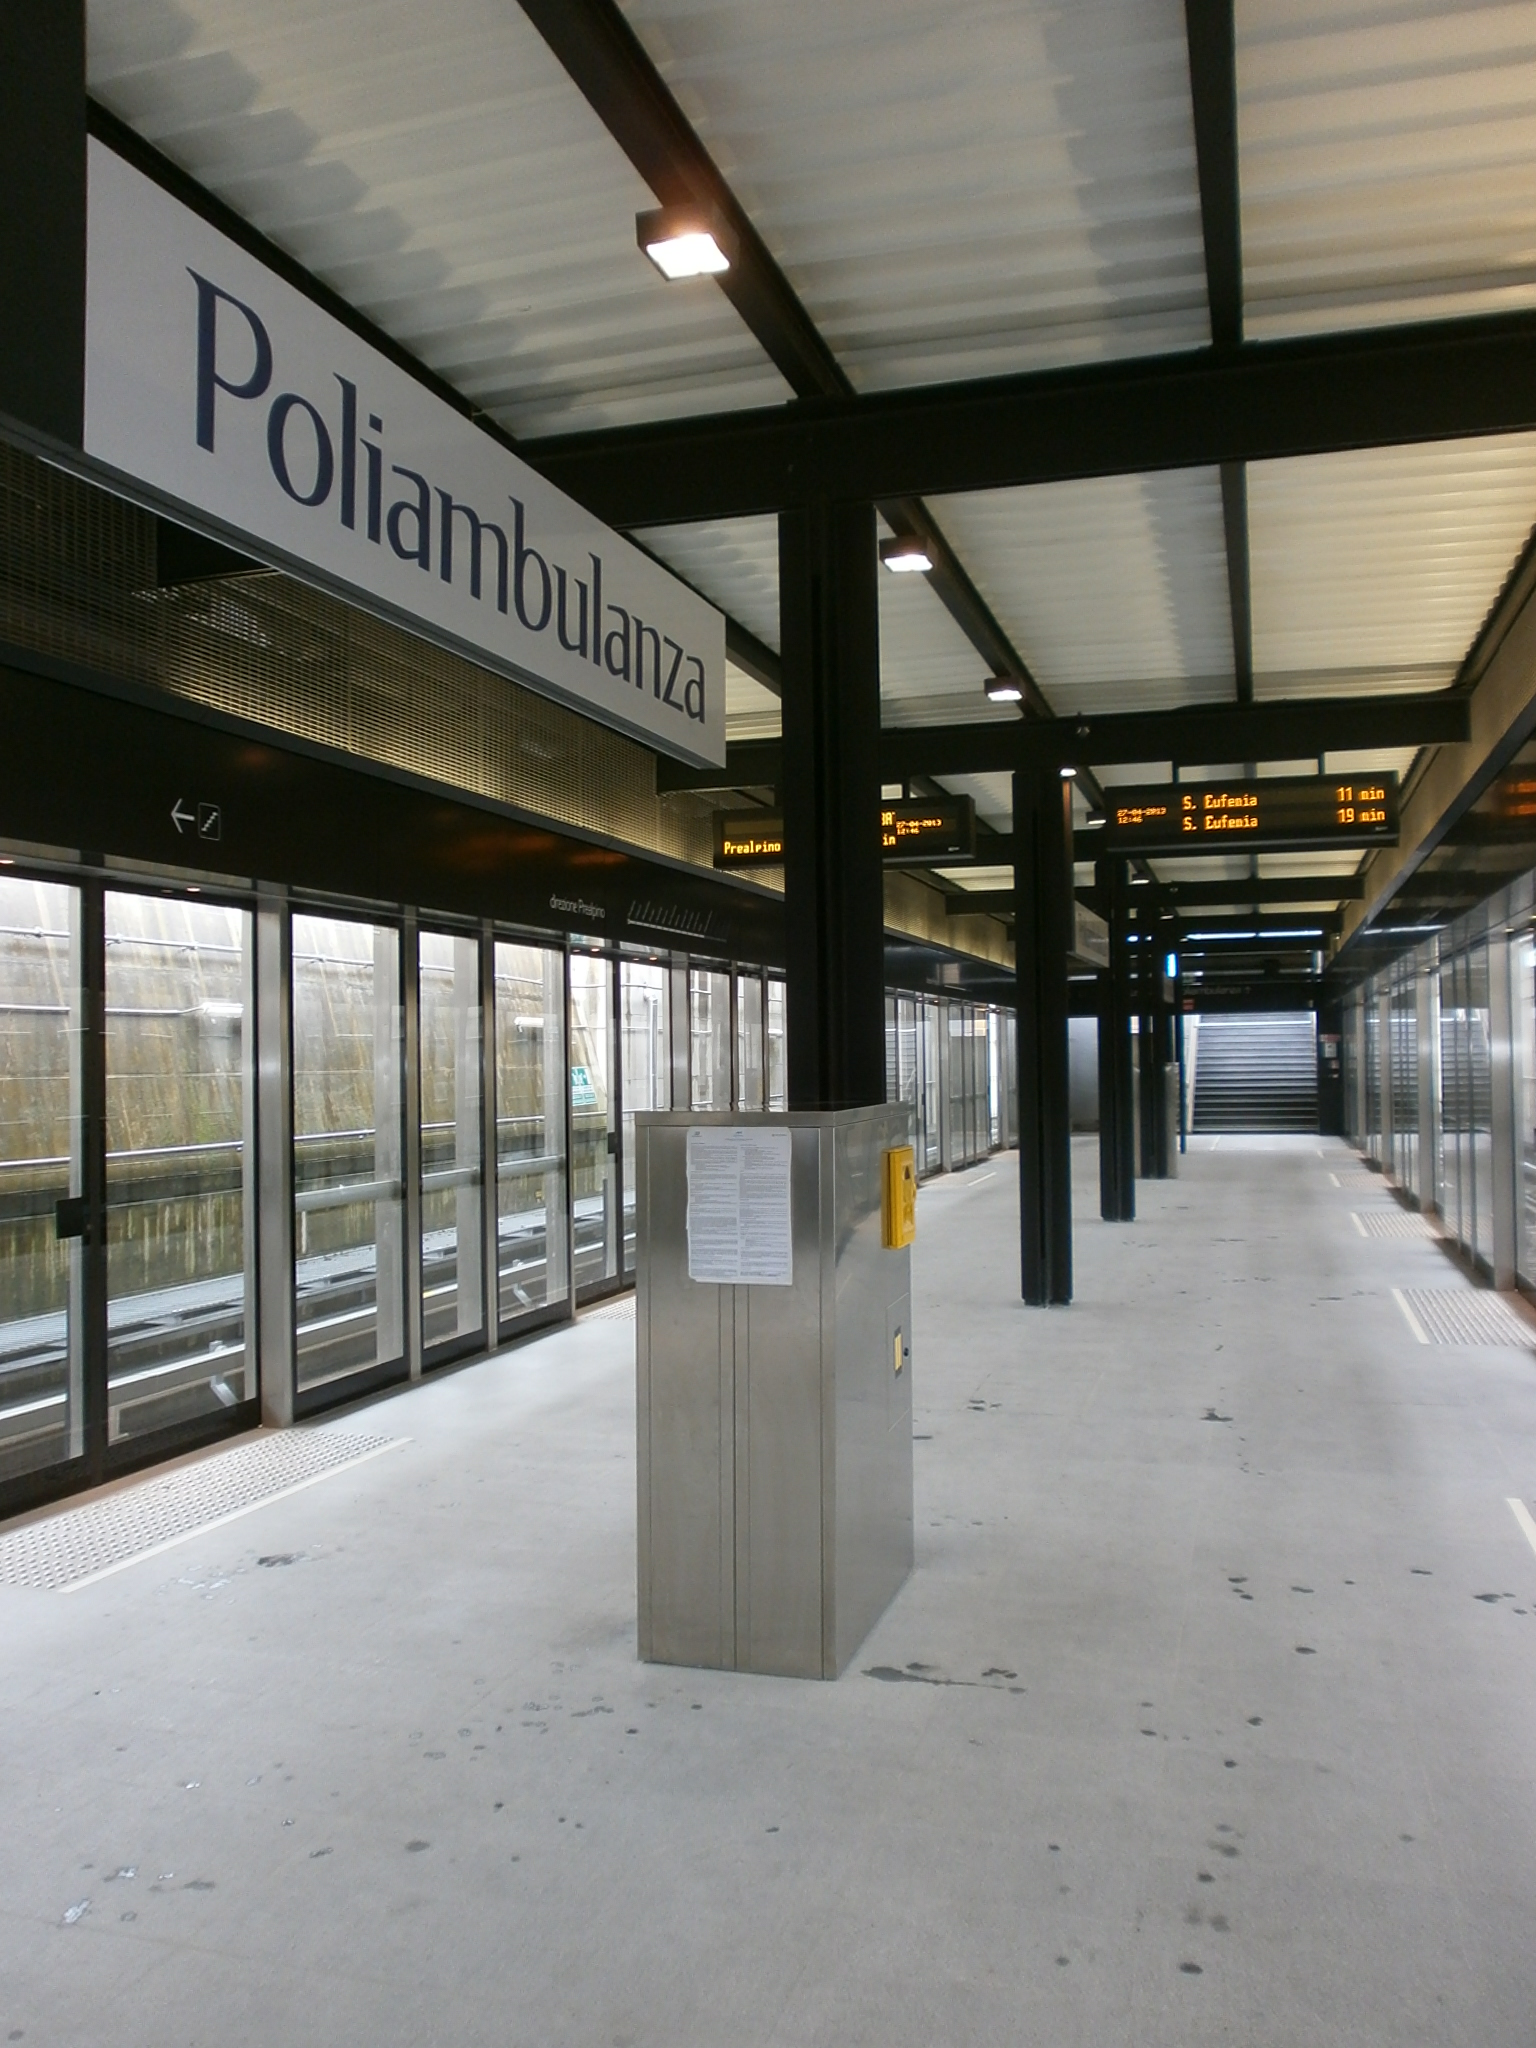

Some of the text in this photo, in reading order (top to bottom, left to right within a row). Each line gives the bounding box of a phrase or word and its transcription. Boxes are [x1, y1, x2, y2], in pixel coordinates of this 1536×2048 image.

[186, 267, 706, 723] Poliambulanza
[1182, 785, 1385, 810] S. Eufemia 11 min
[1182, 807, 1386, 831] S. Eufemia 19 min
[723, 840, 782, 855] Prealpino
[578, 898, 606, 920] Prealpino
